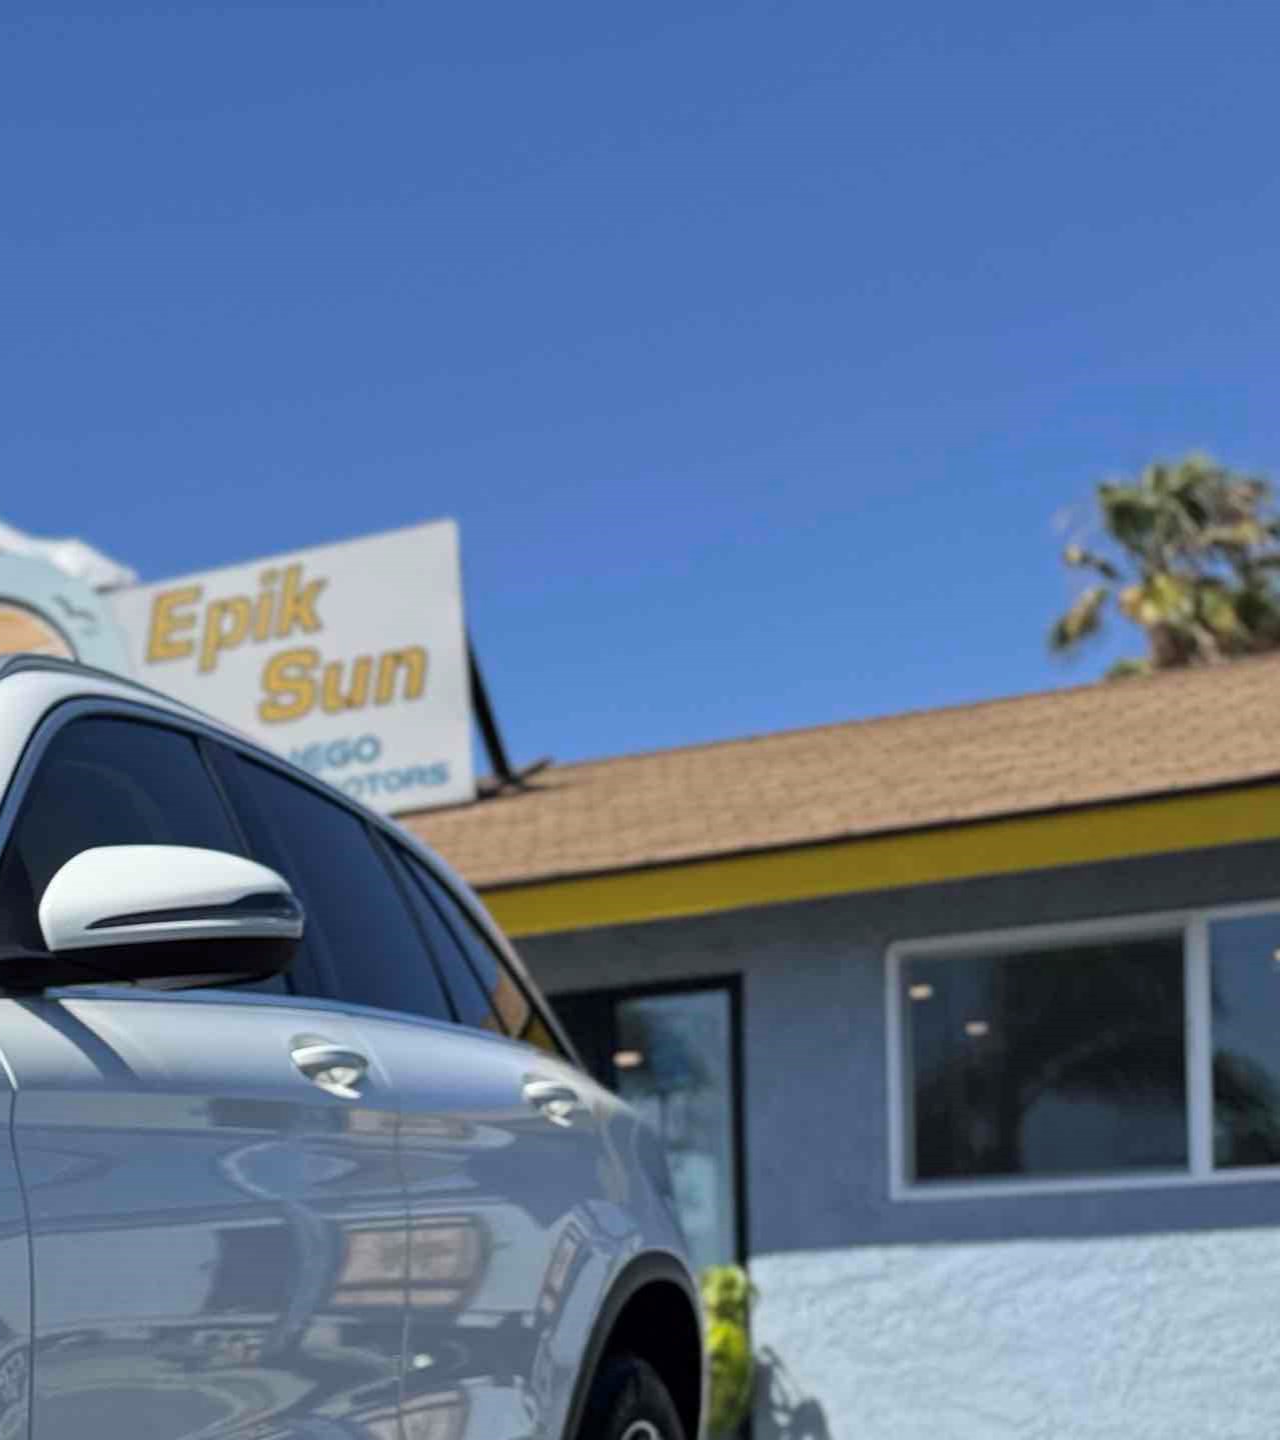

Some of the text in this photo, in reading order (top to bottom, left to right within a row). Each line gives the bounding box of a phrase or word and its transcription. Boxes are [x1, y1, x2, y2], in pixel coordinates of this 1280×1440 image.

[145, 563, 329, 675] Epik
[257, 645, 429, 724] Sun
[289, 735, 381, 769] IEGO
[342, 762, 451, 796] OTORS
